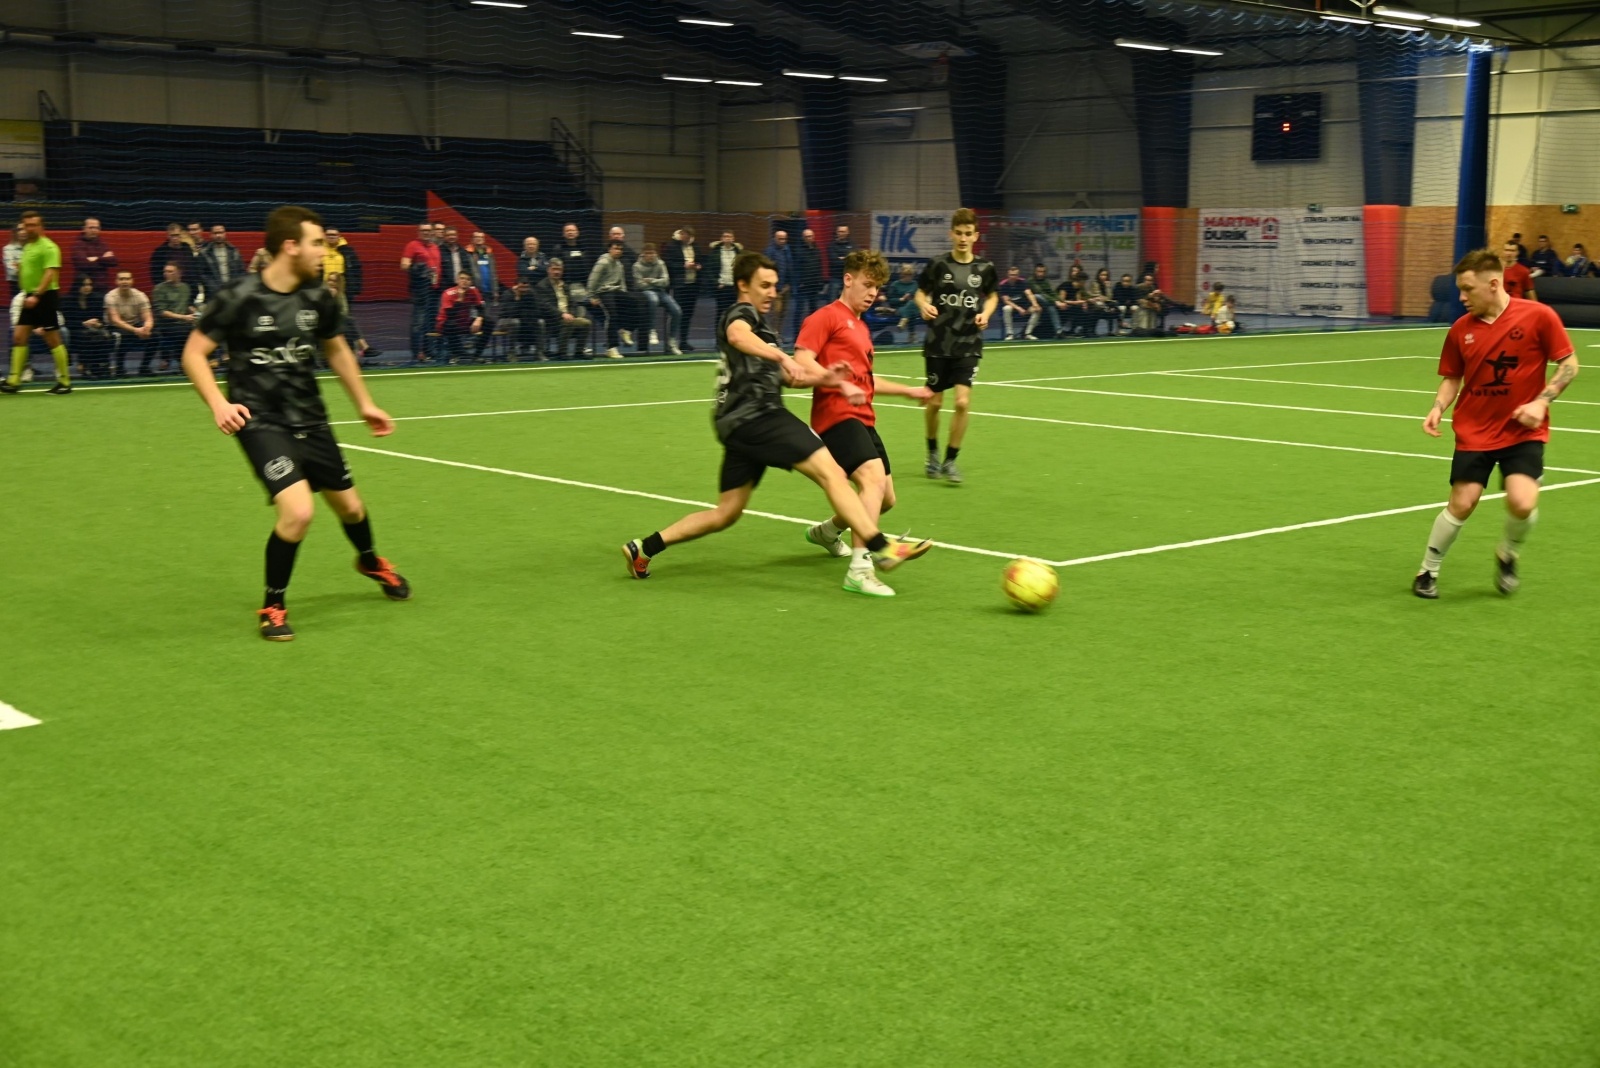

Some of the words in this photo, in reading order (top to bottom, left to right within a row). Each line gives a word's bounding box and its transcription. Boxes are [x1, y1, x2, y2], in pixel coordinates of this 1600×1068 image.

[1045, 214, 1138, 232] INTERNET
[1204, 217, 1260, 227] MARTIN
[1204, 227, 1247, 240] ĎURÍK
[939, 289, 979, 308] safer
